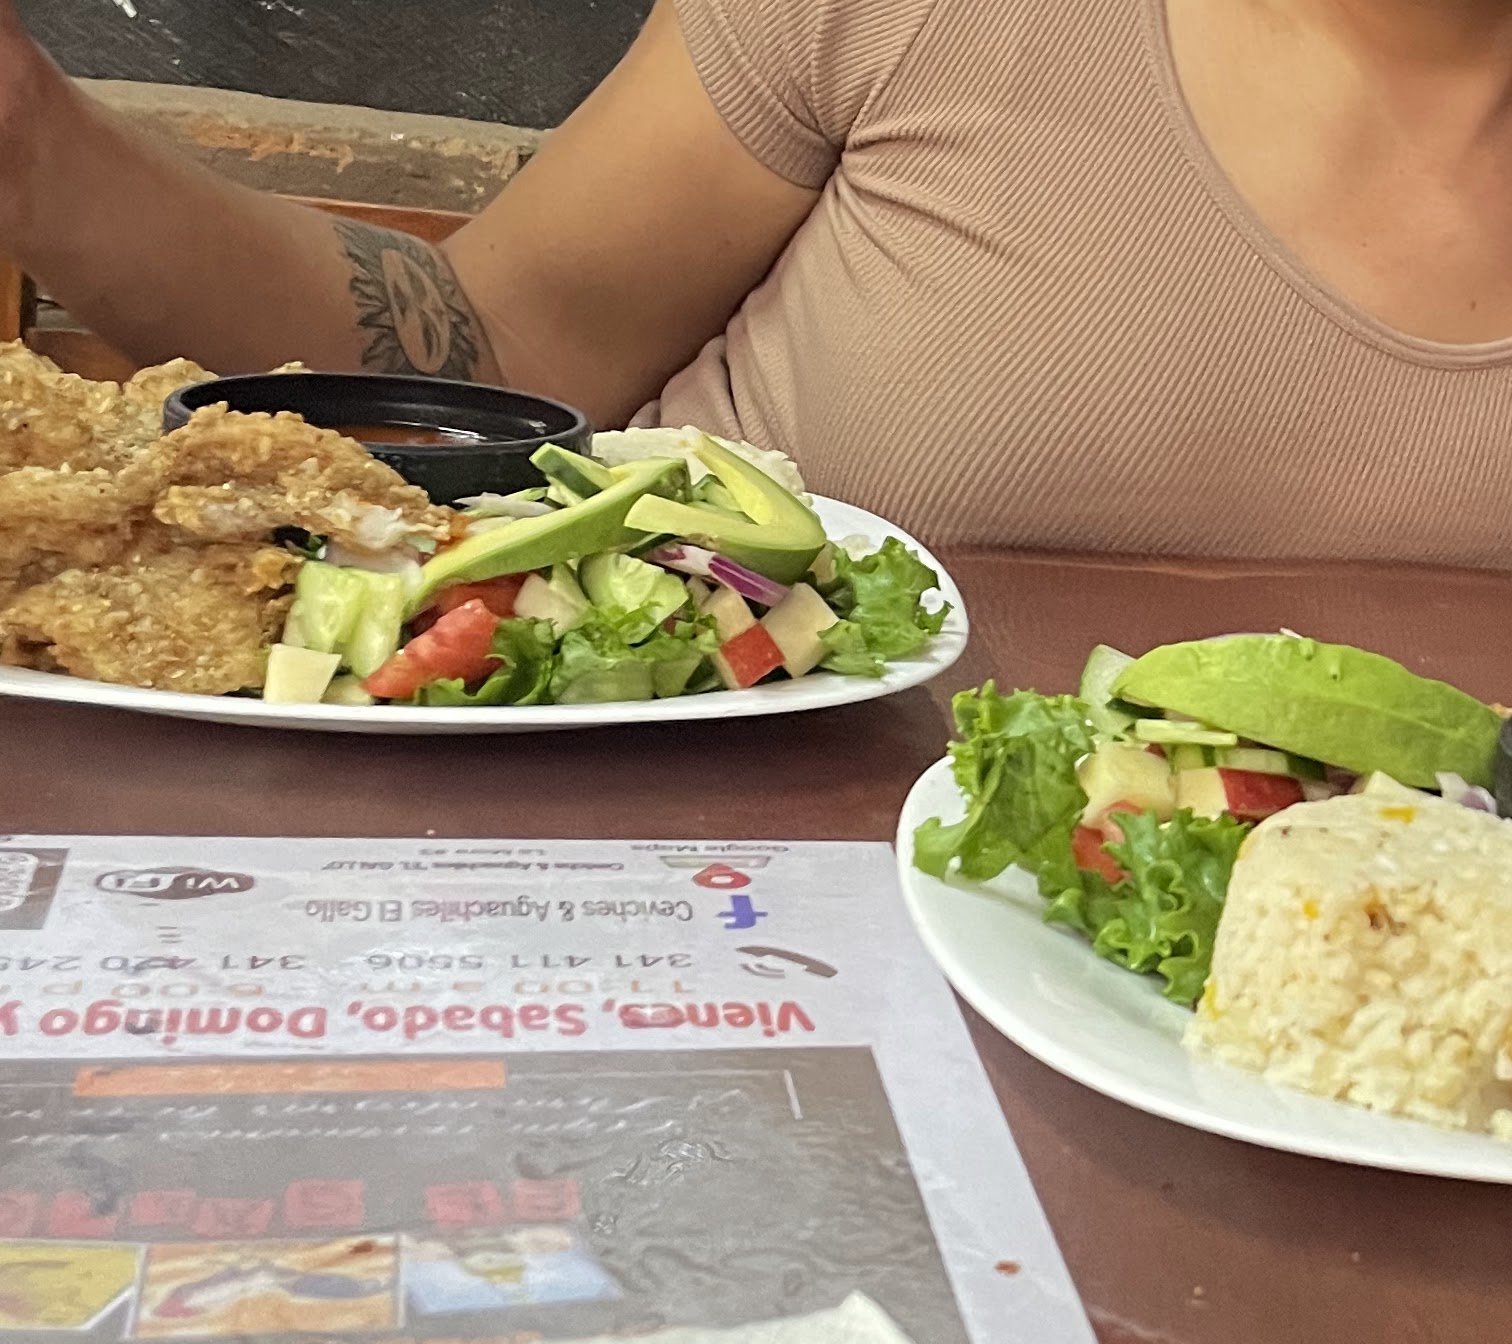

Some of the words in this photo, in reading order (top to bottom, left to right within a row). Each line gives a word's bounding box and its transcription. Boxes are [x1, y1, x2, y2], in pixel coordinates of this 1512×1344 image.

[630, 842, 698, 854] Maps
[706, 843, 789, 854] Google
[304, 899, 372, 923] Gallo
[378, 899, 403, 922] El
[411, 894, 551, 923] Aguachiles
[558, 900, 576, 922] &
[583, 900, 693, 923] Ceviches
[221, 954, 306, 971] 341
[510, 953, 592, 970] 411
[615, 953, 693, 970] 341
[39, 999, 327, 1045] Domingo
[347, 1000, 588, 1040] Sabado,
